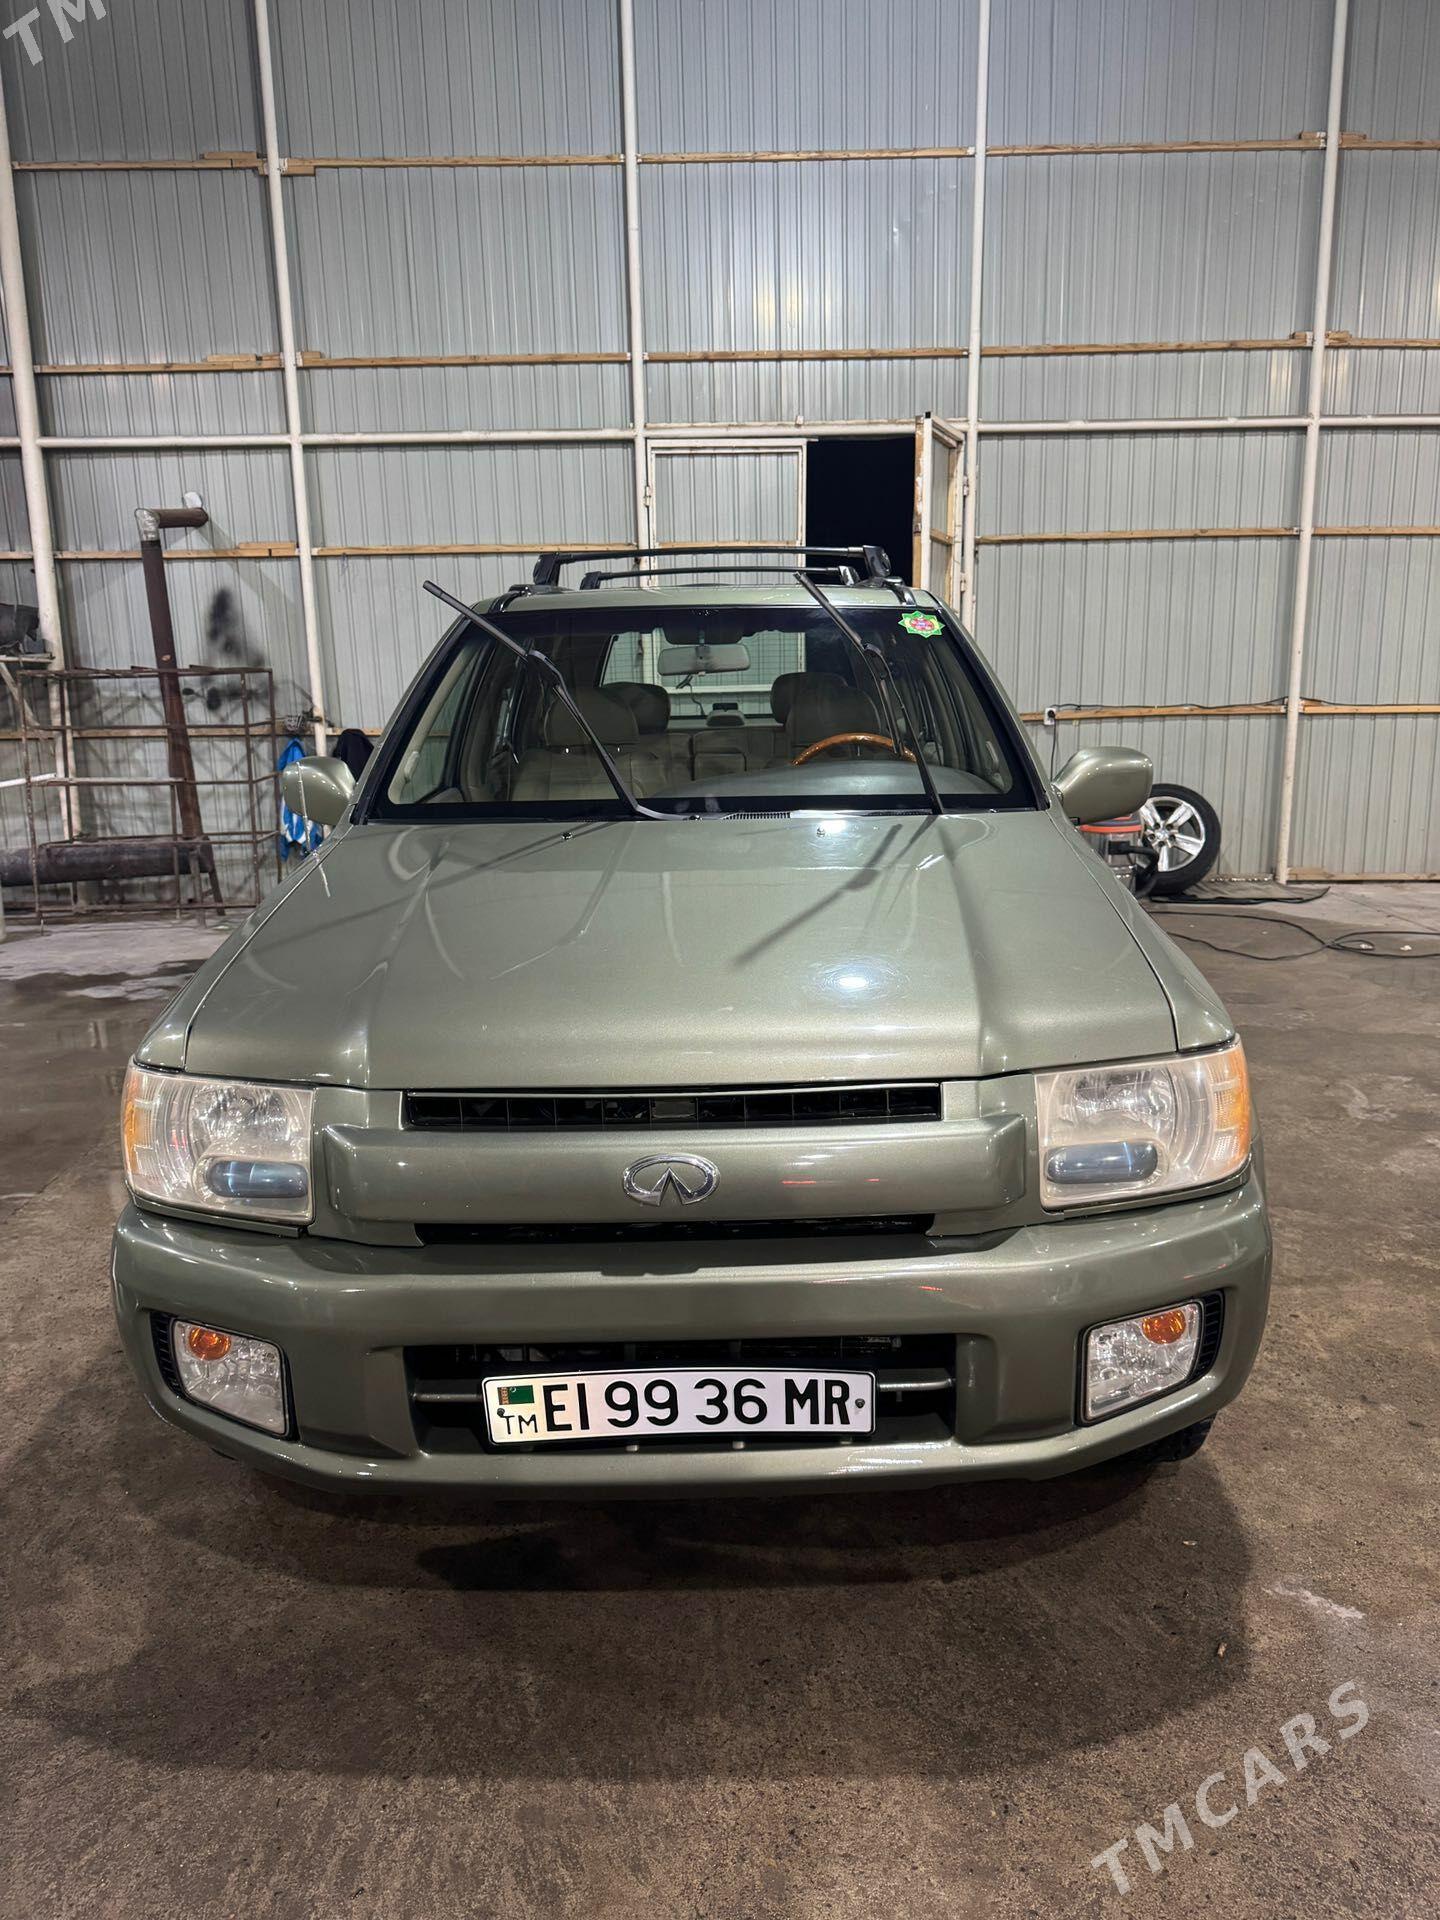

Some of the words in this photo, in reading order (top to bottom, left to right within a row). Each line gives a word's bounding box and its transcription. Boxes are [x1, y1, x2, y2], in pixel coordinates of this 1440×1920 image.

[542, 1383, 591, 1432] EI
[604, 1379, 679, 1428] 99
[694, 1378, 768, 1425] 36
[784, 1378, 850, 1425] MR
[502, 1414, 538, 1435] TM
